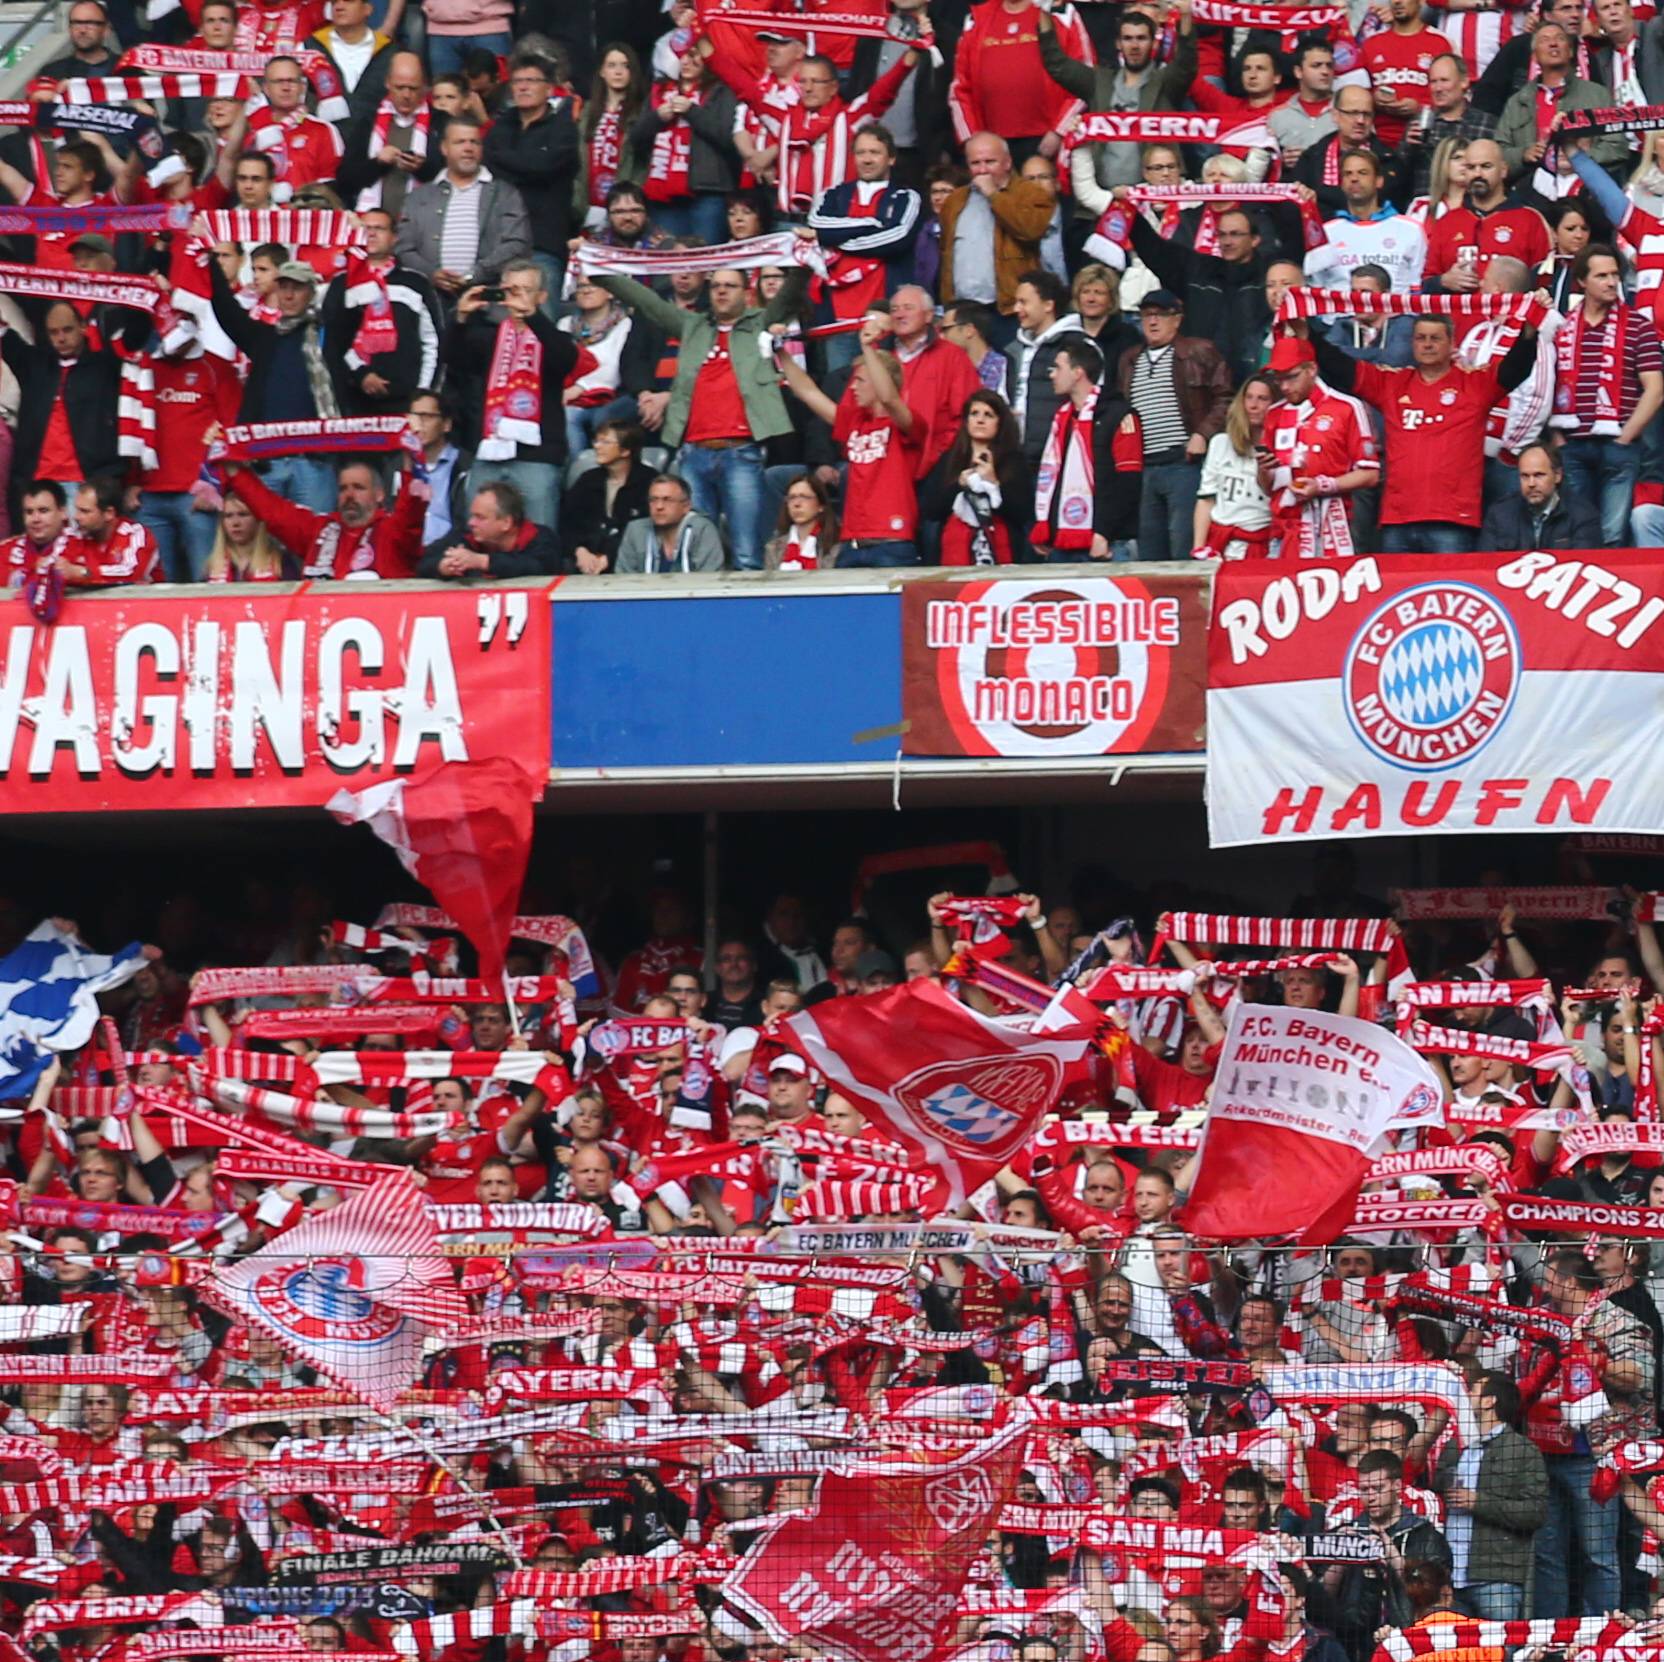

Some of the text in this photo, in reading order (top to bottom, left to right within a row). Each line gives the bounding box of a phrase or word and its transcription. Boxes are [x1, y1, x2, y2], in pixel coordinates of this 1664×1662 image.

[54, 103, 138, 130] ARSENAL
[926, 597, 1180, 648] INFLESSIBILE
[1221, 555, 1383, 663] RODA
[1357, 592, 1510, 666] FC BAYERN
[0, 592, 528, 780] AGINGA”
[973, 677, 1135, 724] MONACO
[1355, 687, 1505, 761] MÜNCHEN
[1261, 777, 1614, 835] HAUFN
[1233, 1042, 1349, 1076] München
[1290, 1019, 1382, 1064] Bayern
[1411, 1024, 1529, 1060] SAN MIA
[1506, 1199, 1642, 1228] CHAMPIONS
[1089, 1520, 1225, 1553] SAN MIA
